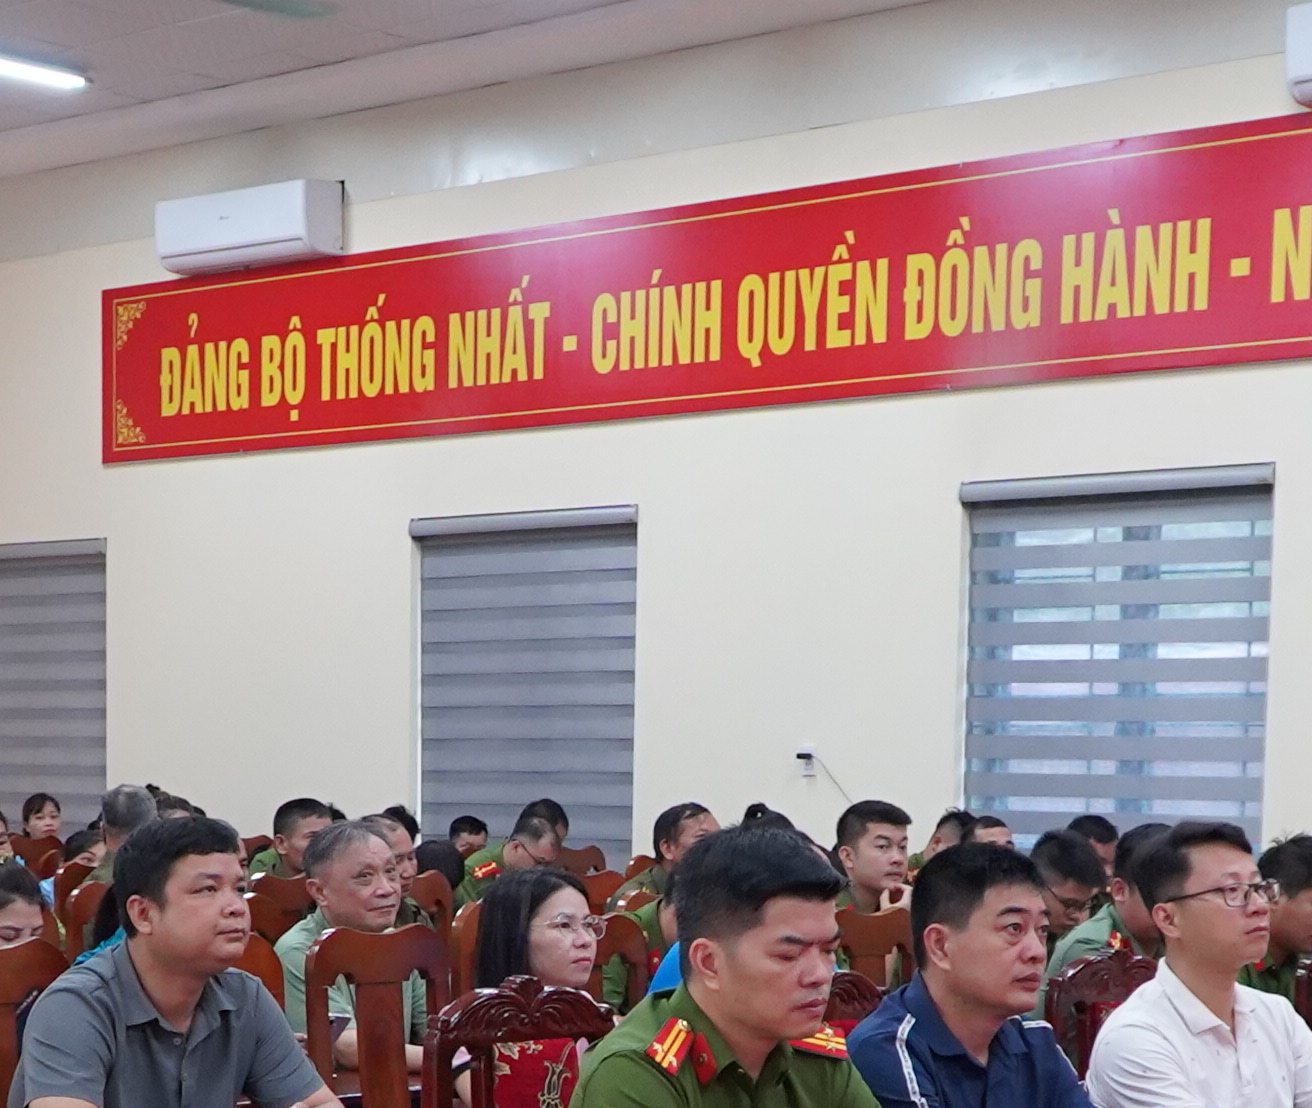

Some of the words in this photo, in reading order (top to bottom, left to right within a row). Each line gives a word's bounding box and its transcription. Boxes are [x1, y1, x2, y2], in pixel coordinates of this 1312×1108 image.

[159, 313, 250, 417] ĐẢNG
[259, 322, 306, 422] BỘ
[316, 293, 436, 402] THỐNG
[447, 274, 551, 389] NHẤT
[590, 268, 723, 374] CHÍNH
[735, 230, 889, 368] QUYỀN
[902, 216, 1043, 341] ĐỒNG
[1059, 208, 1213, 325] HÀNH
